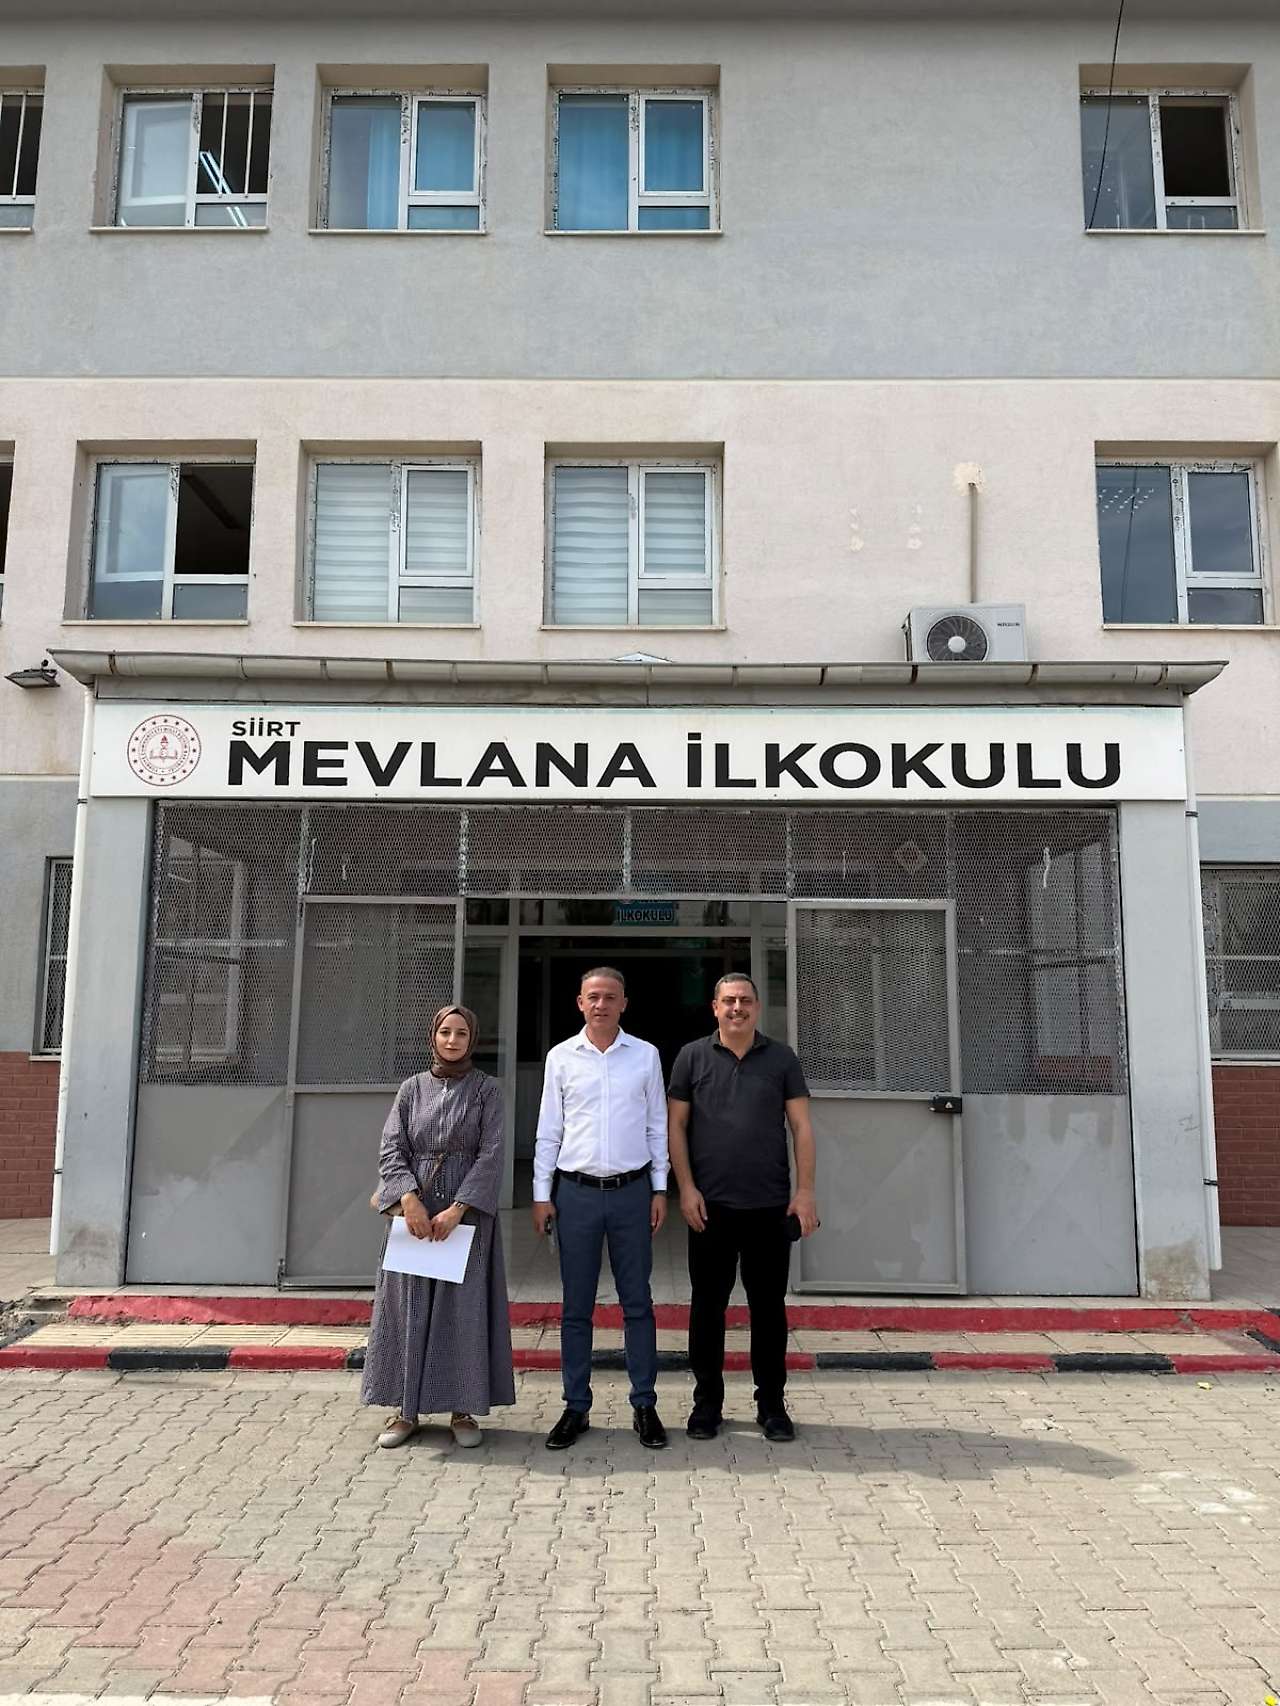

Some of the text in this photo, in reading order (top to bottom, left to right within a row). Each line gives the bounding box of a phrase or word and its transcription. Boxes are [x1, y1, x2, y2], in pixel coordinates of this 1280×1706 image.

[231, 717, 301, 737] SİİRT
[227, 740, 657, 788] MEVLANA
[687, 732, 1121, 789] İLKOKULU
